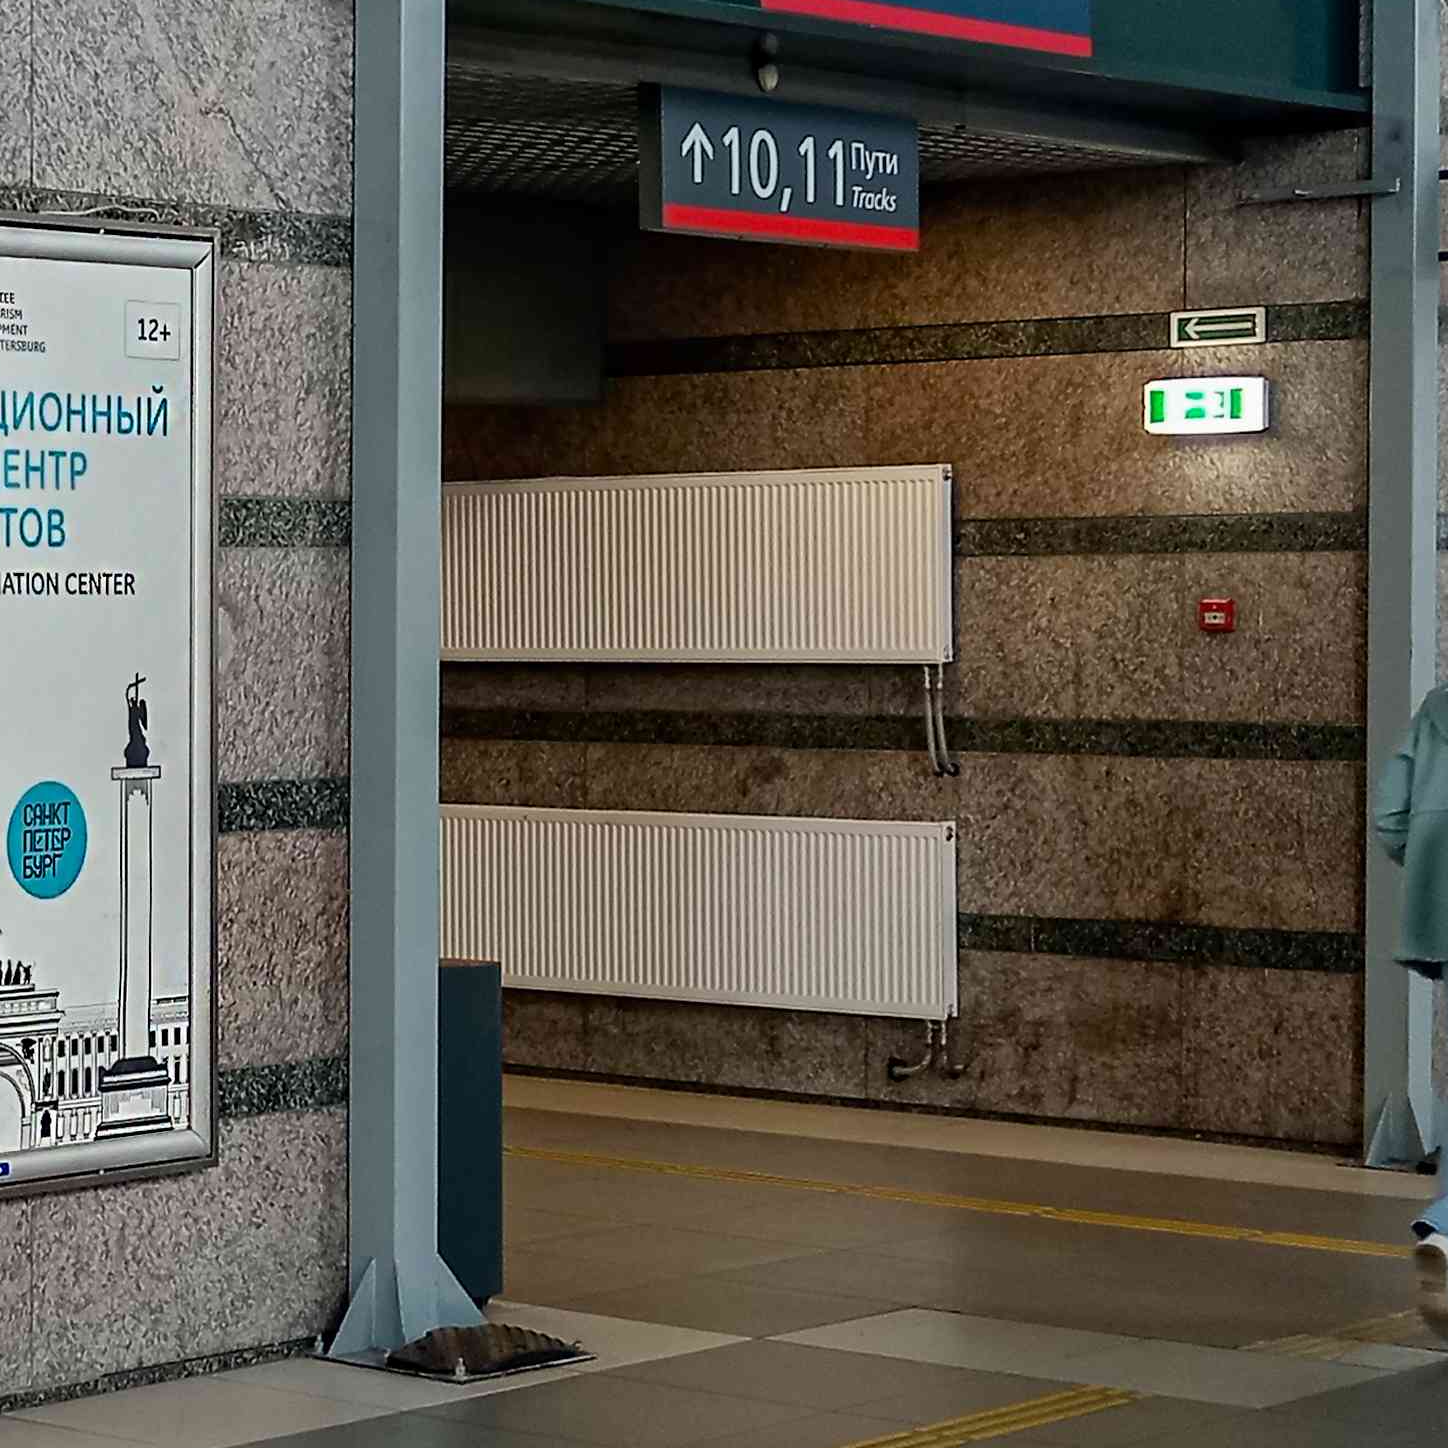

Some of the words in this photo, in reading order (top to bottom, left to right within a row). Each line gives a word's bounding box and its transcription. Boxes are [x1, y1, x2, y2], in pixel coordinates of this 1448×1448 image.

[850, 141, 899, 181] Пути
[851, 185, 897, 213] Tracks
[137, 318, 172, 343] 12+
[64, 572, 136, 597] CENTER
[22, 800, 72, 827] САНКТ
[22, 827, 72, 853] ПЕТЕР
[22, 853, 63, 880] БУРГ
